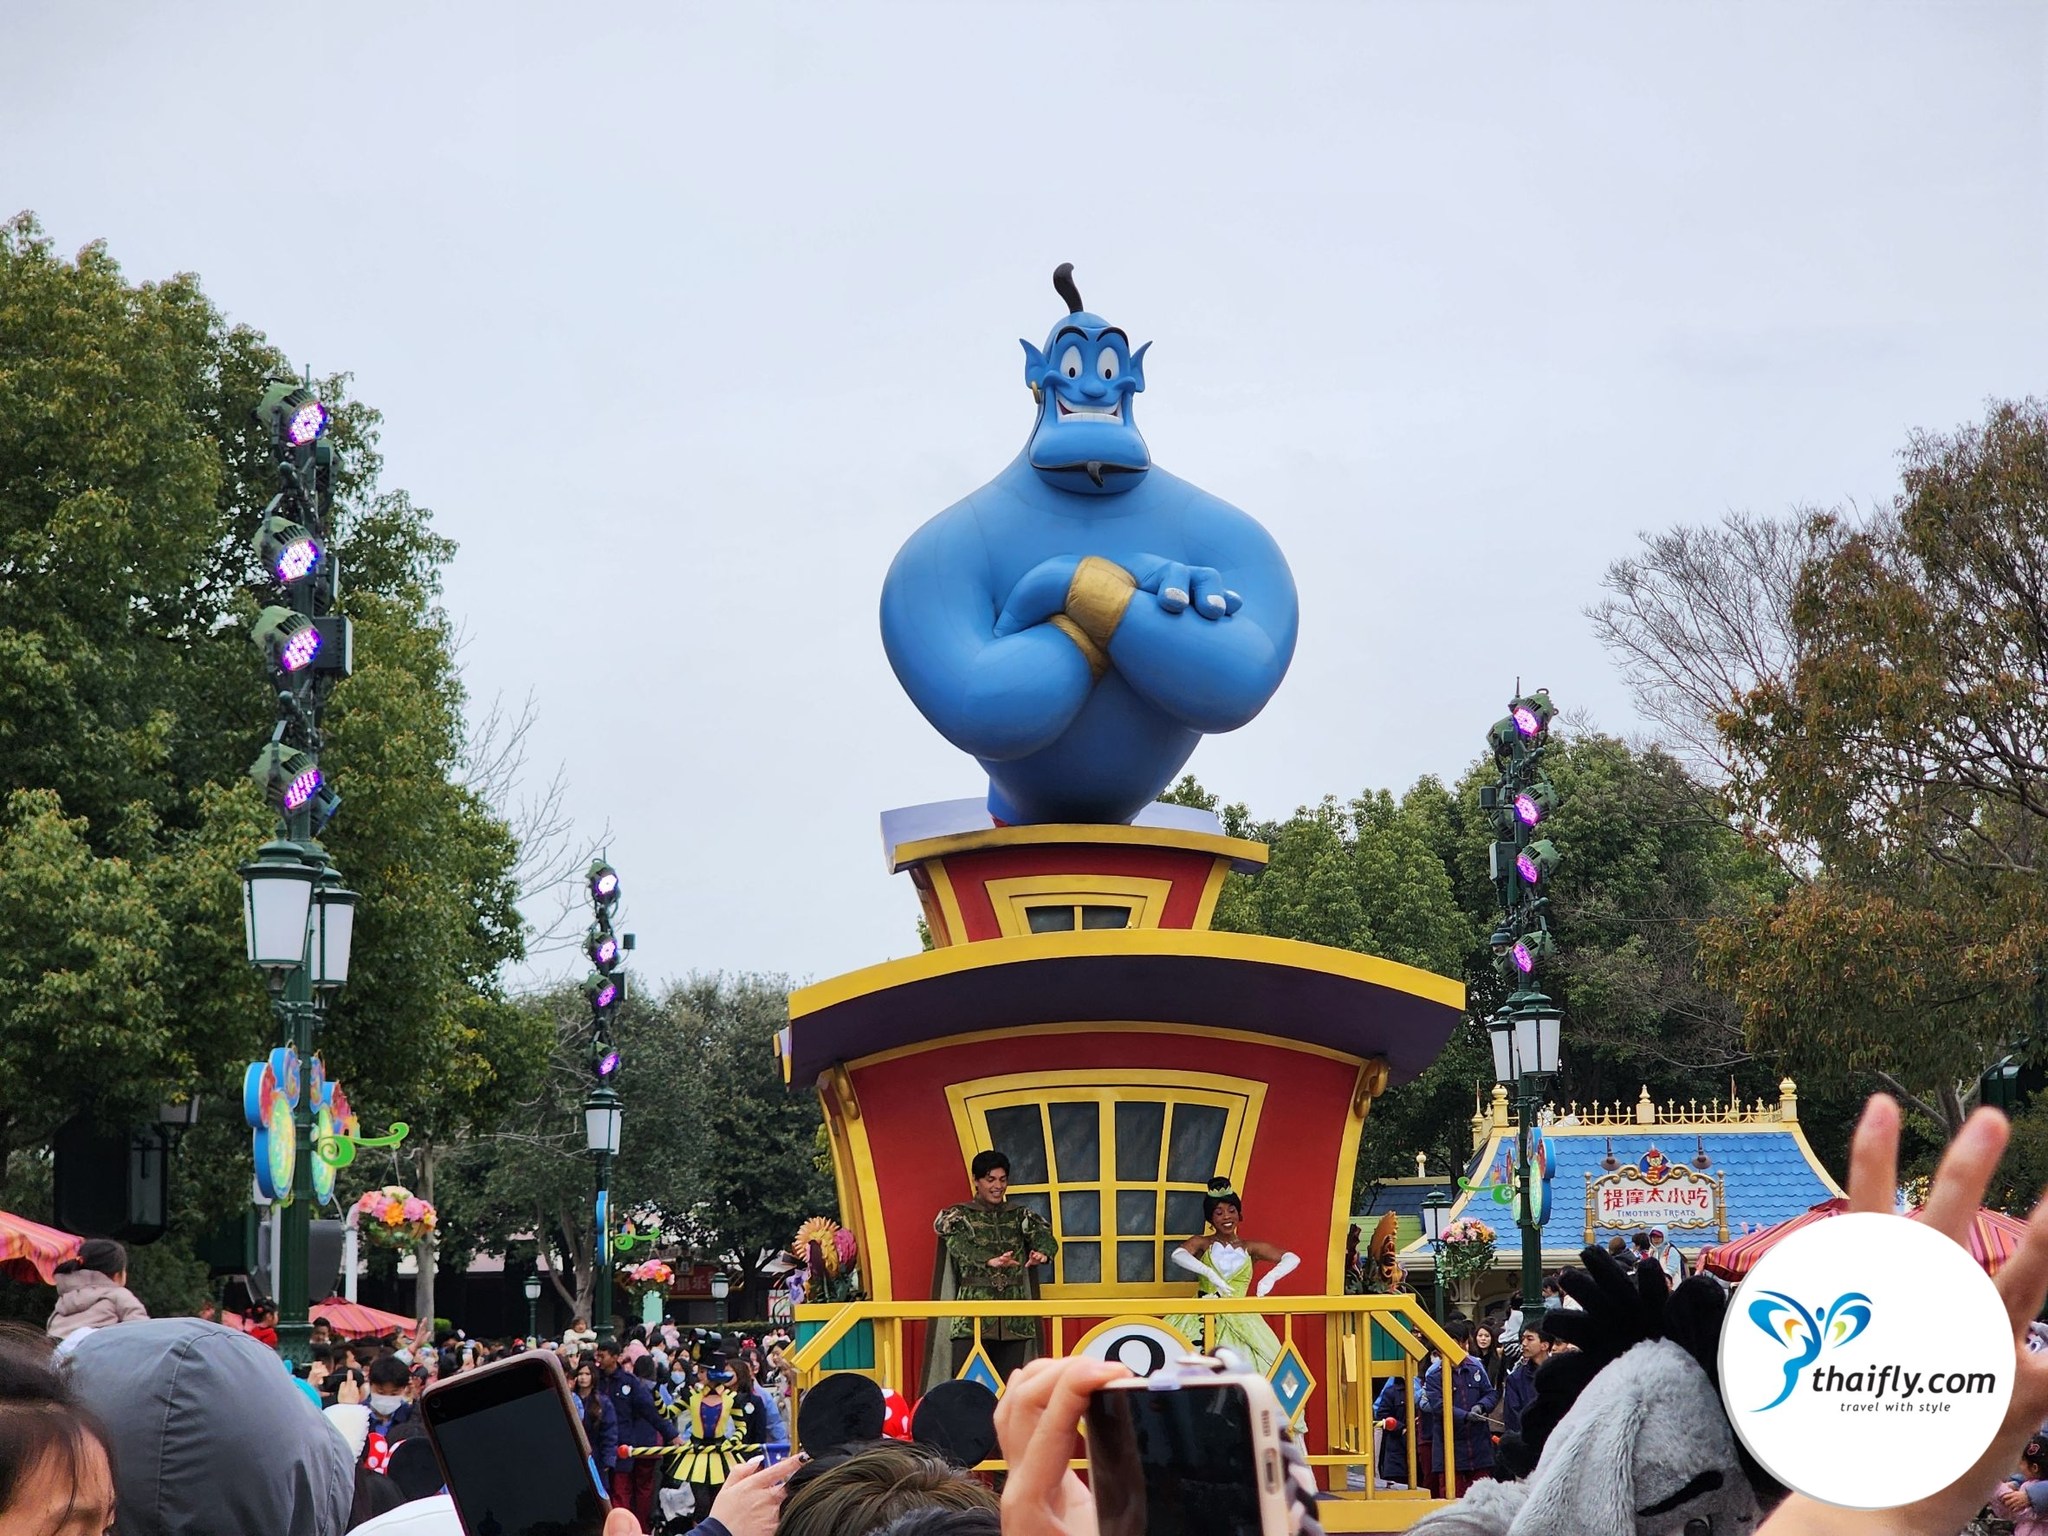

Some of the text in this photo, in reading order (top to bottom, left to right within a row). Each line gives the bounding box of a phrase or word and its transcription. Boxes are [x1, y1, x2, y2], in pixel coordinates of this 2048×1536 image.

[1603, 1187, 1708, 1211] 提摩太小吃
[1616, 1208, 1696, 1218] TIMOTHY'S TREATS
